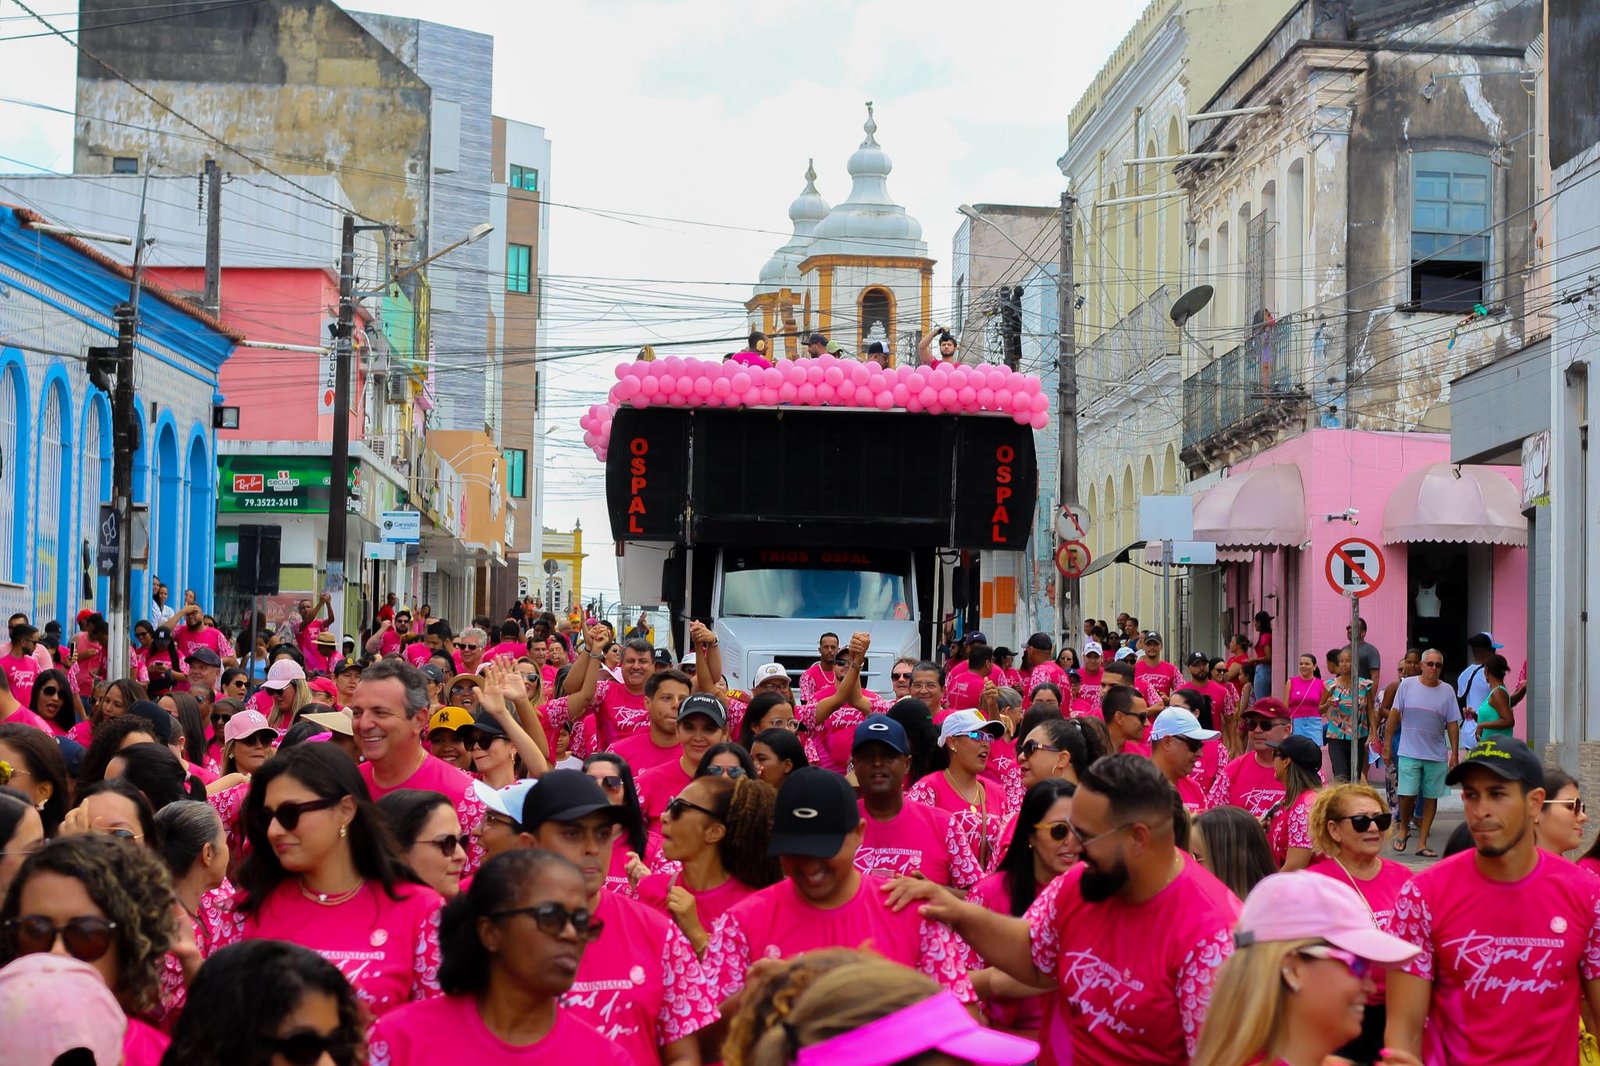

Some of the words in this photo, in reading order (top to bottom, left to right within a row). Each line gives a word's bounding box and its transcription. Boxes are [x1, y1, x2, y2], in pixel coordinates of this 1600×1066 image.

[629, 437, 649, 534] OSPAL
[991, 445, 1015, 543] OSPAL
[244, 498, 299, 507] 79.3522-2418
[760, 550, 809, 563] TRIOS
[821, 552, 872, 565] OSPAL
[693, 696, 715, 705] SPORT
